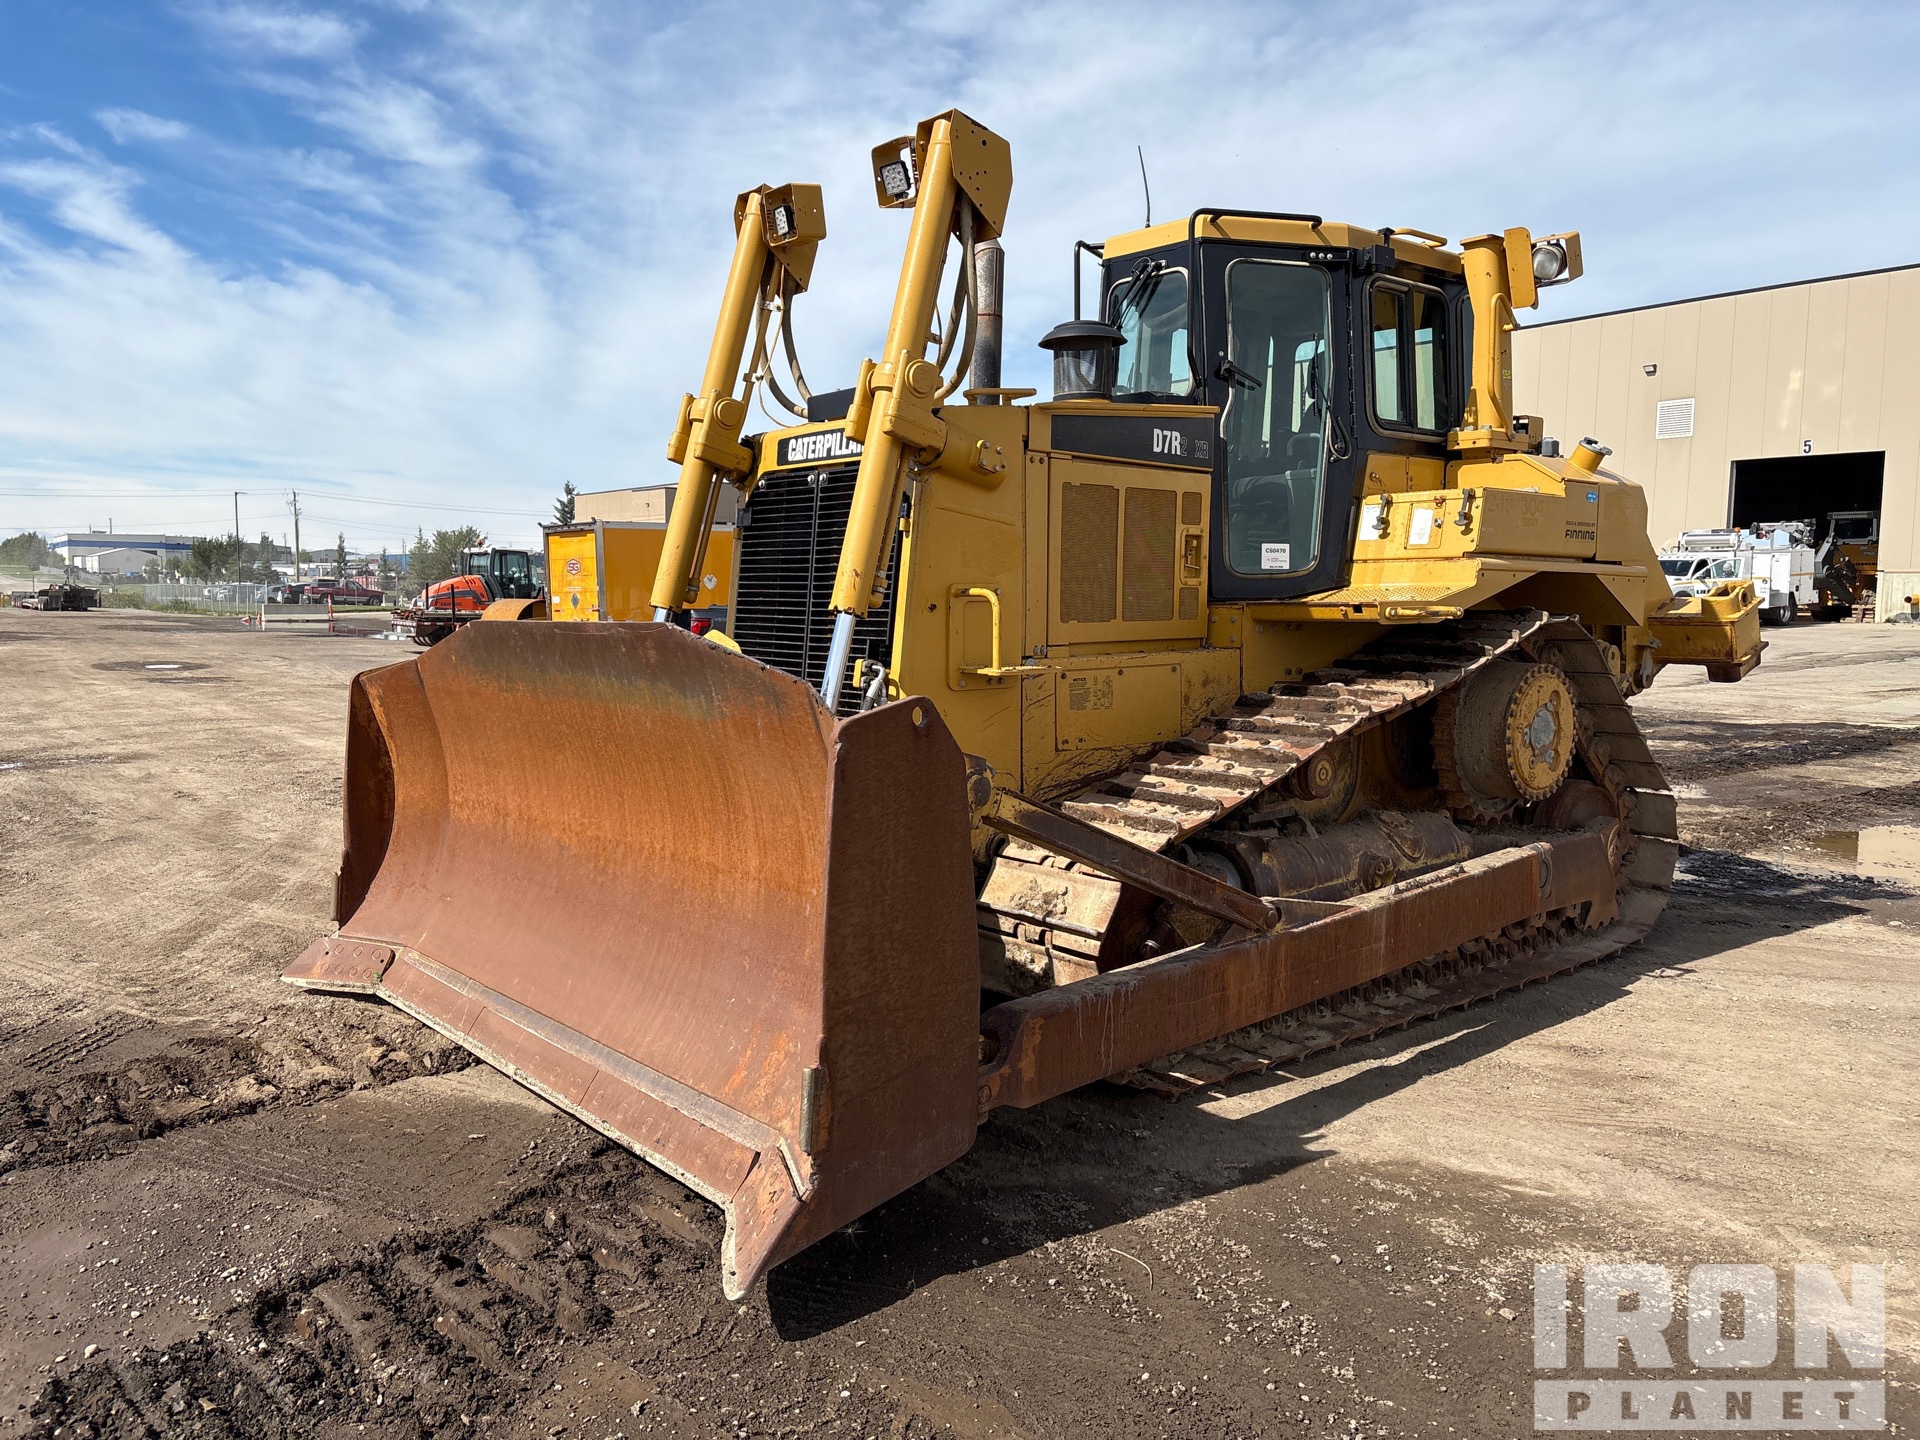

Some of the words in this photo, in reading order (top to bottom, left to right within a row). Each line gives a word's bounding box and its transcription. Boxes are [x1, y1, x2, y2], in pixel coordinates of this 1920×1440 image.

[787, 431, 864, 462] CATERPILLA
[1803, 439, 1812, 454] 5
[1564, 529, 1595, 541] FINNING
